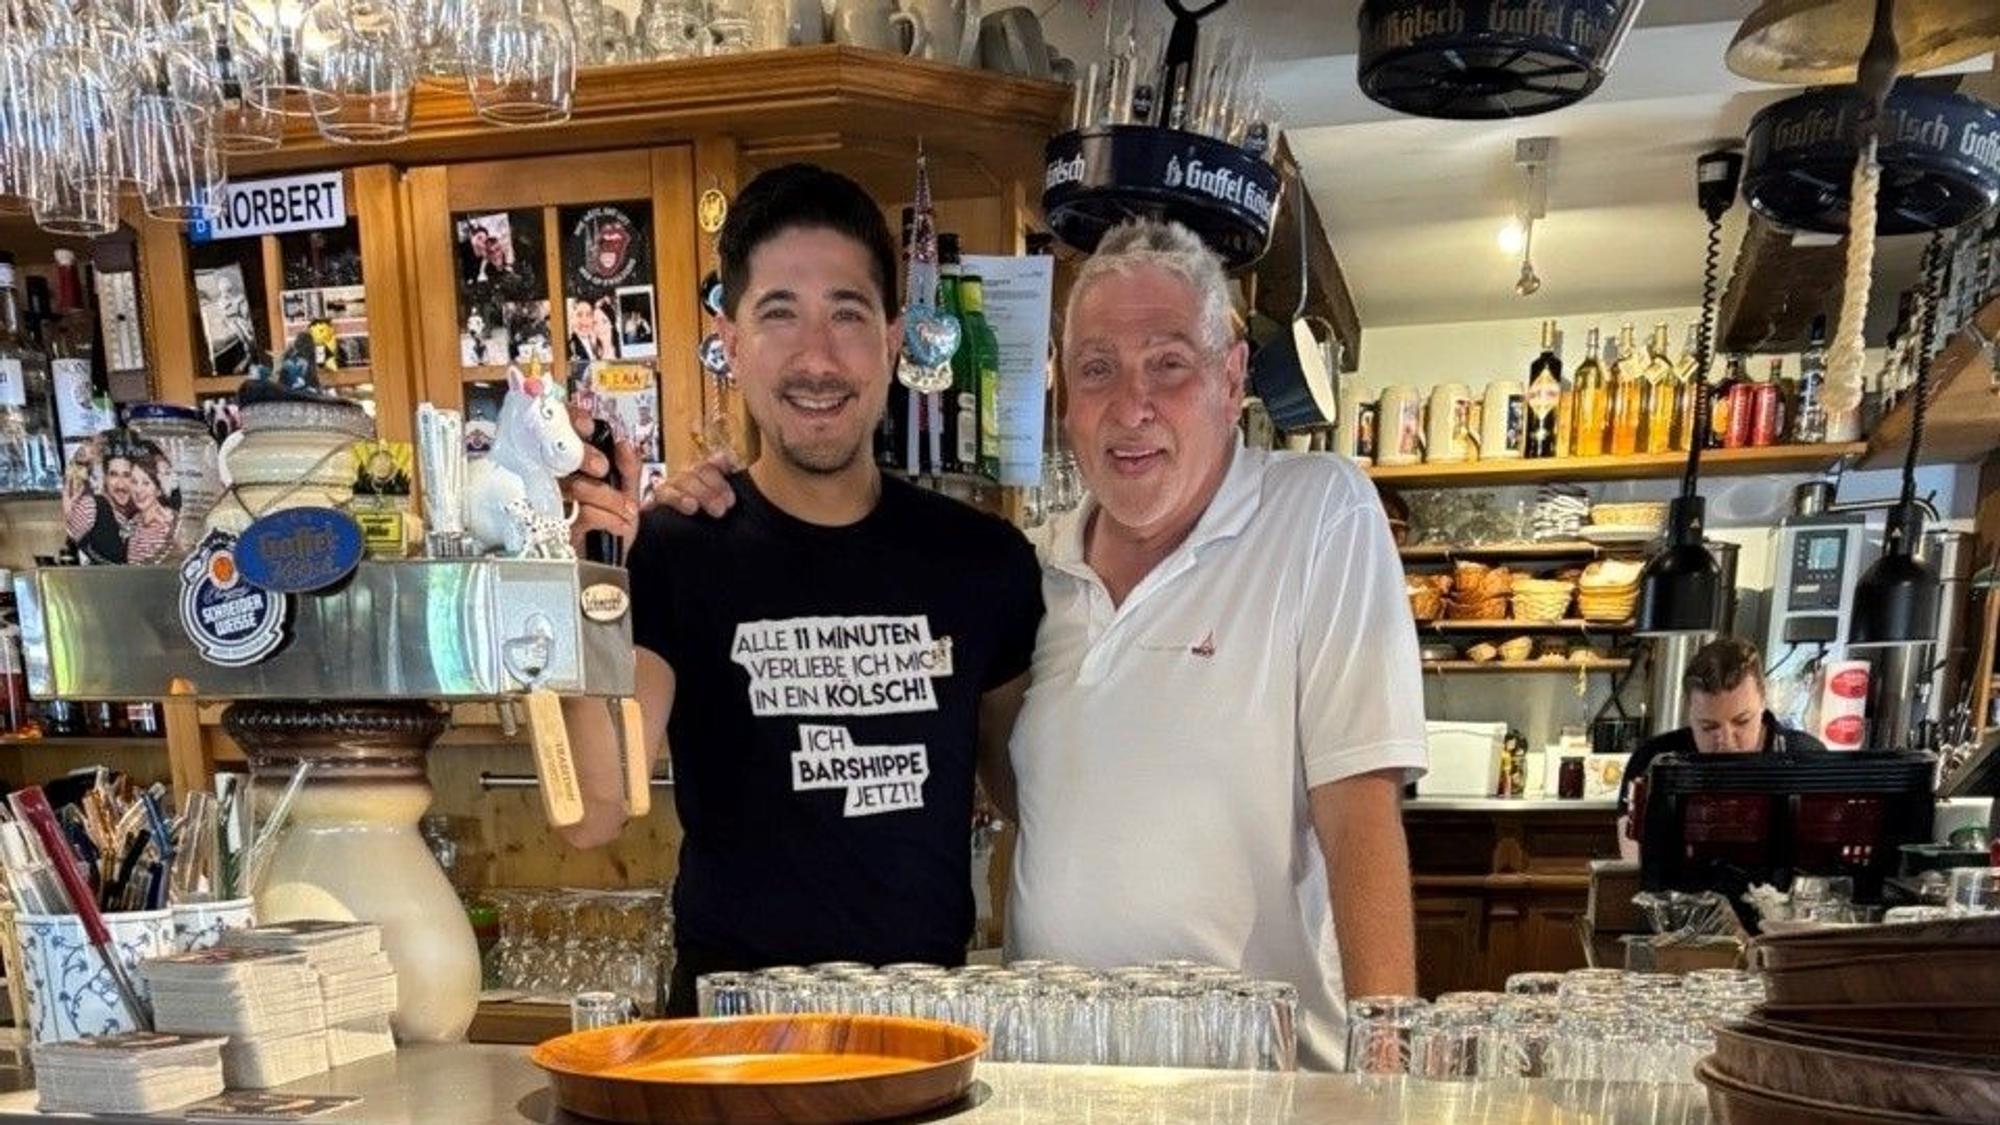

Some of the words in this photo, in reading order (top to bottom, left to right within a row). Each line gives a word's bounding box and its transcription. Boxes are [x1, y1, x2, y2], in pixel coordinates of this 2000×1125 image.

[1185, 160, 1243, 204] Gaffel
[215, 182, 336, 230] NORBERT
[736, 629, 789, 655] ALLE
[793, 627, 811, 650] 11
[817, 623, 922, 650] MINUTEN
[751, 655, 848, 679] VERLIEBE
[853, 653, 890, 677] ICH
[755, 688, 778, 710] IN
[784, 686, 820, 709] EIN
[825, 677, 928, 709] KÖLSCH!
[807, 729, 845, 752] ICH
[800, 752, 923, 783] BARSHIPPE
[853, 783, 919, 809] JETZT!
